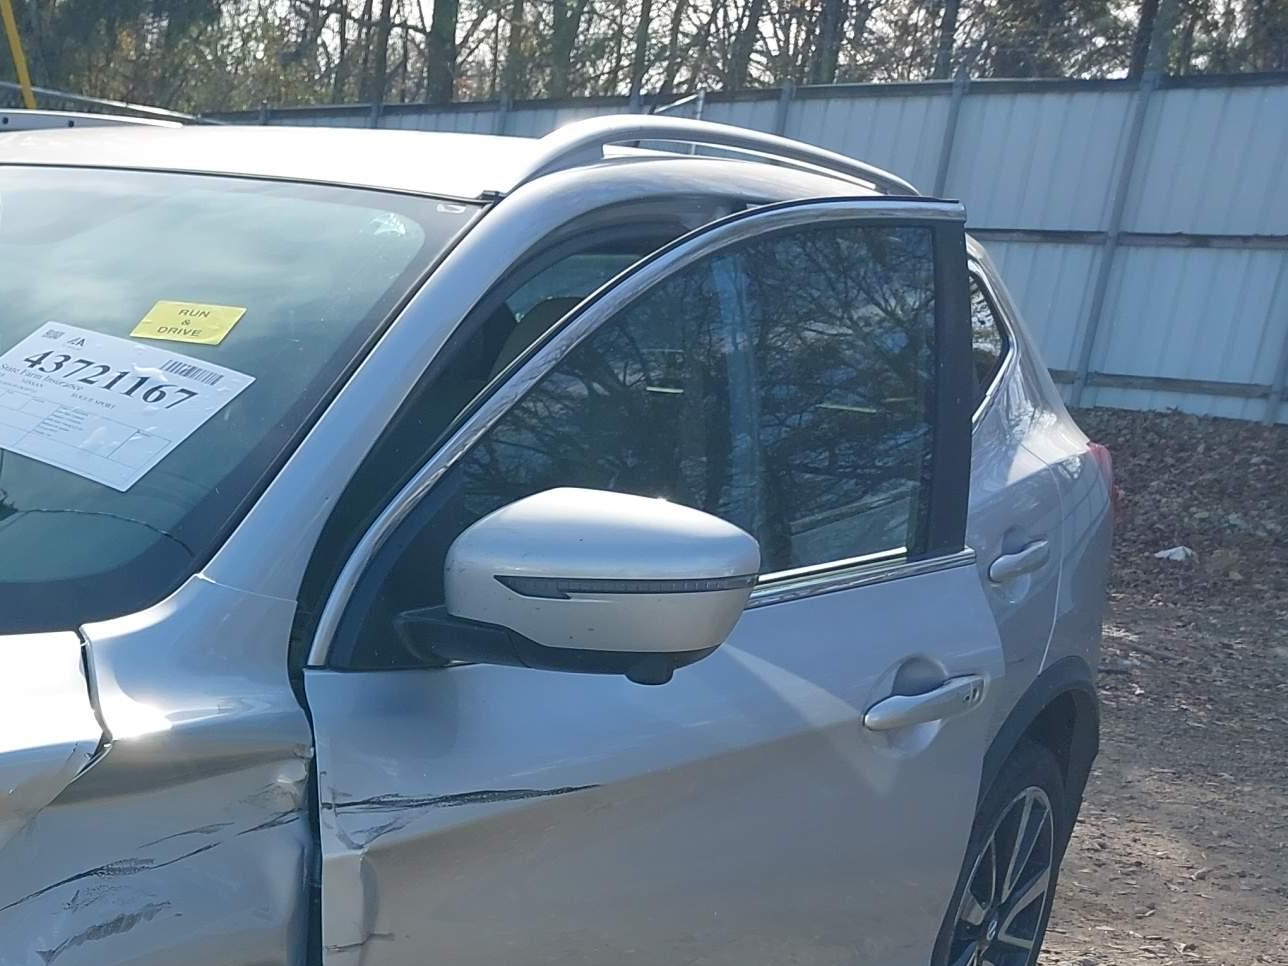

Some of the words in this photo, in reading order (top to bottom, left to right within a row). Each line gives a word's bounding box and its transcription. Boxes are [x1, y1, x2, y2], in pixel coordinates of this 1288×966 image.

[178, 308, 210, 318] RUN
[180, 319, 191, 327] &
[157, 326, 202, 337] DRIVE
[24, 350, 199, 410] 43721167
